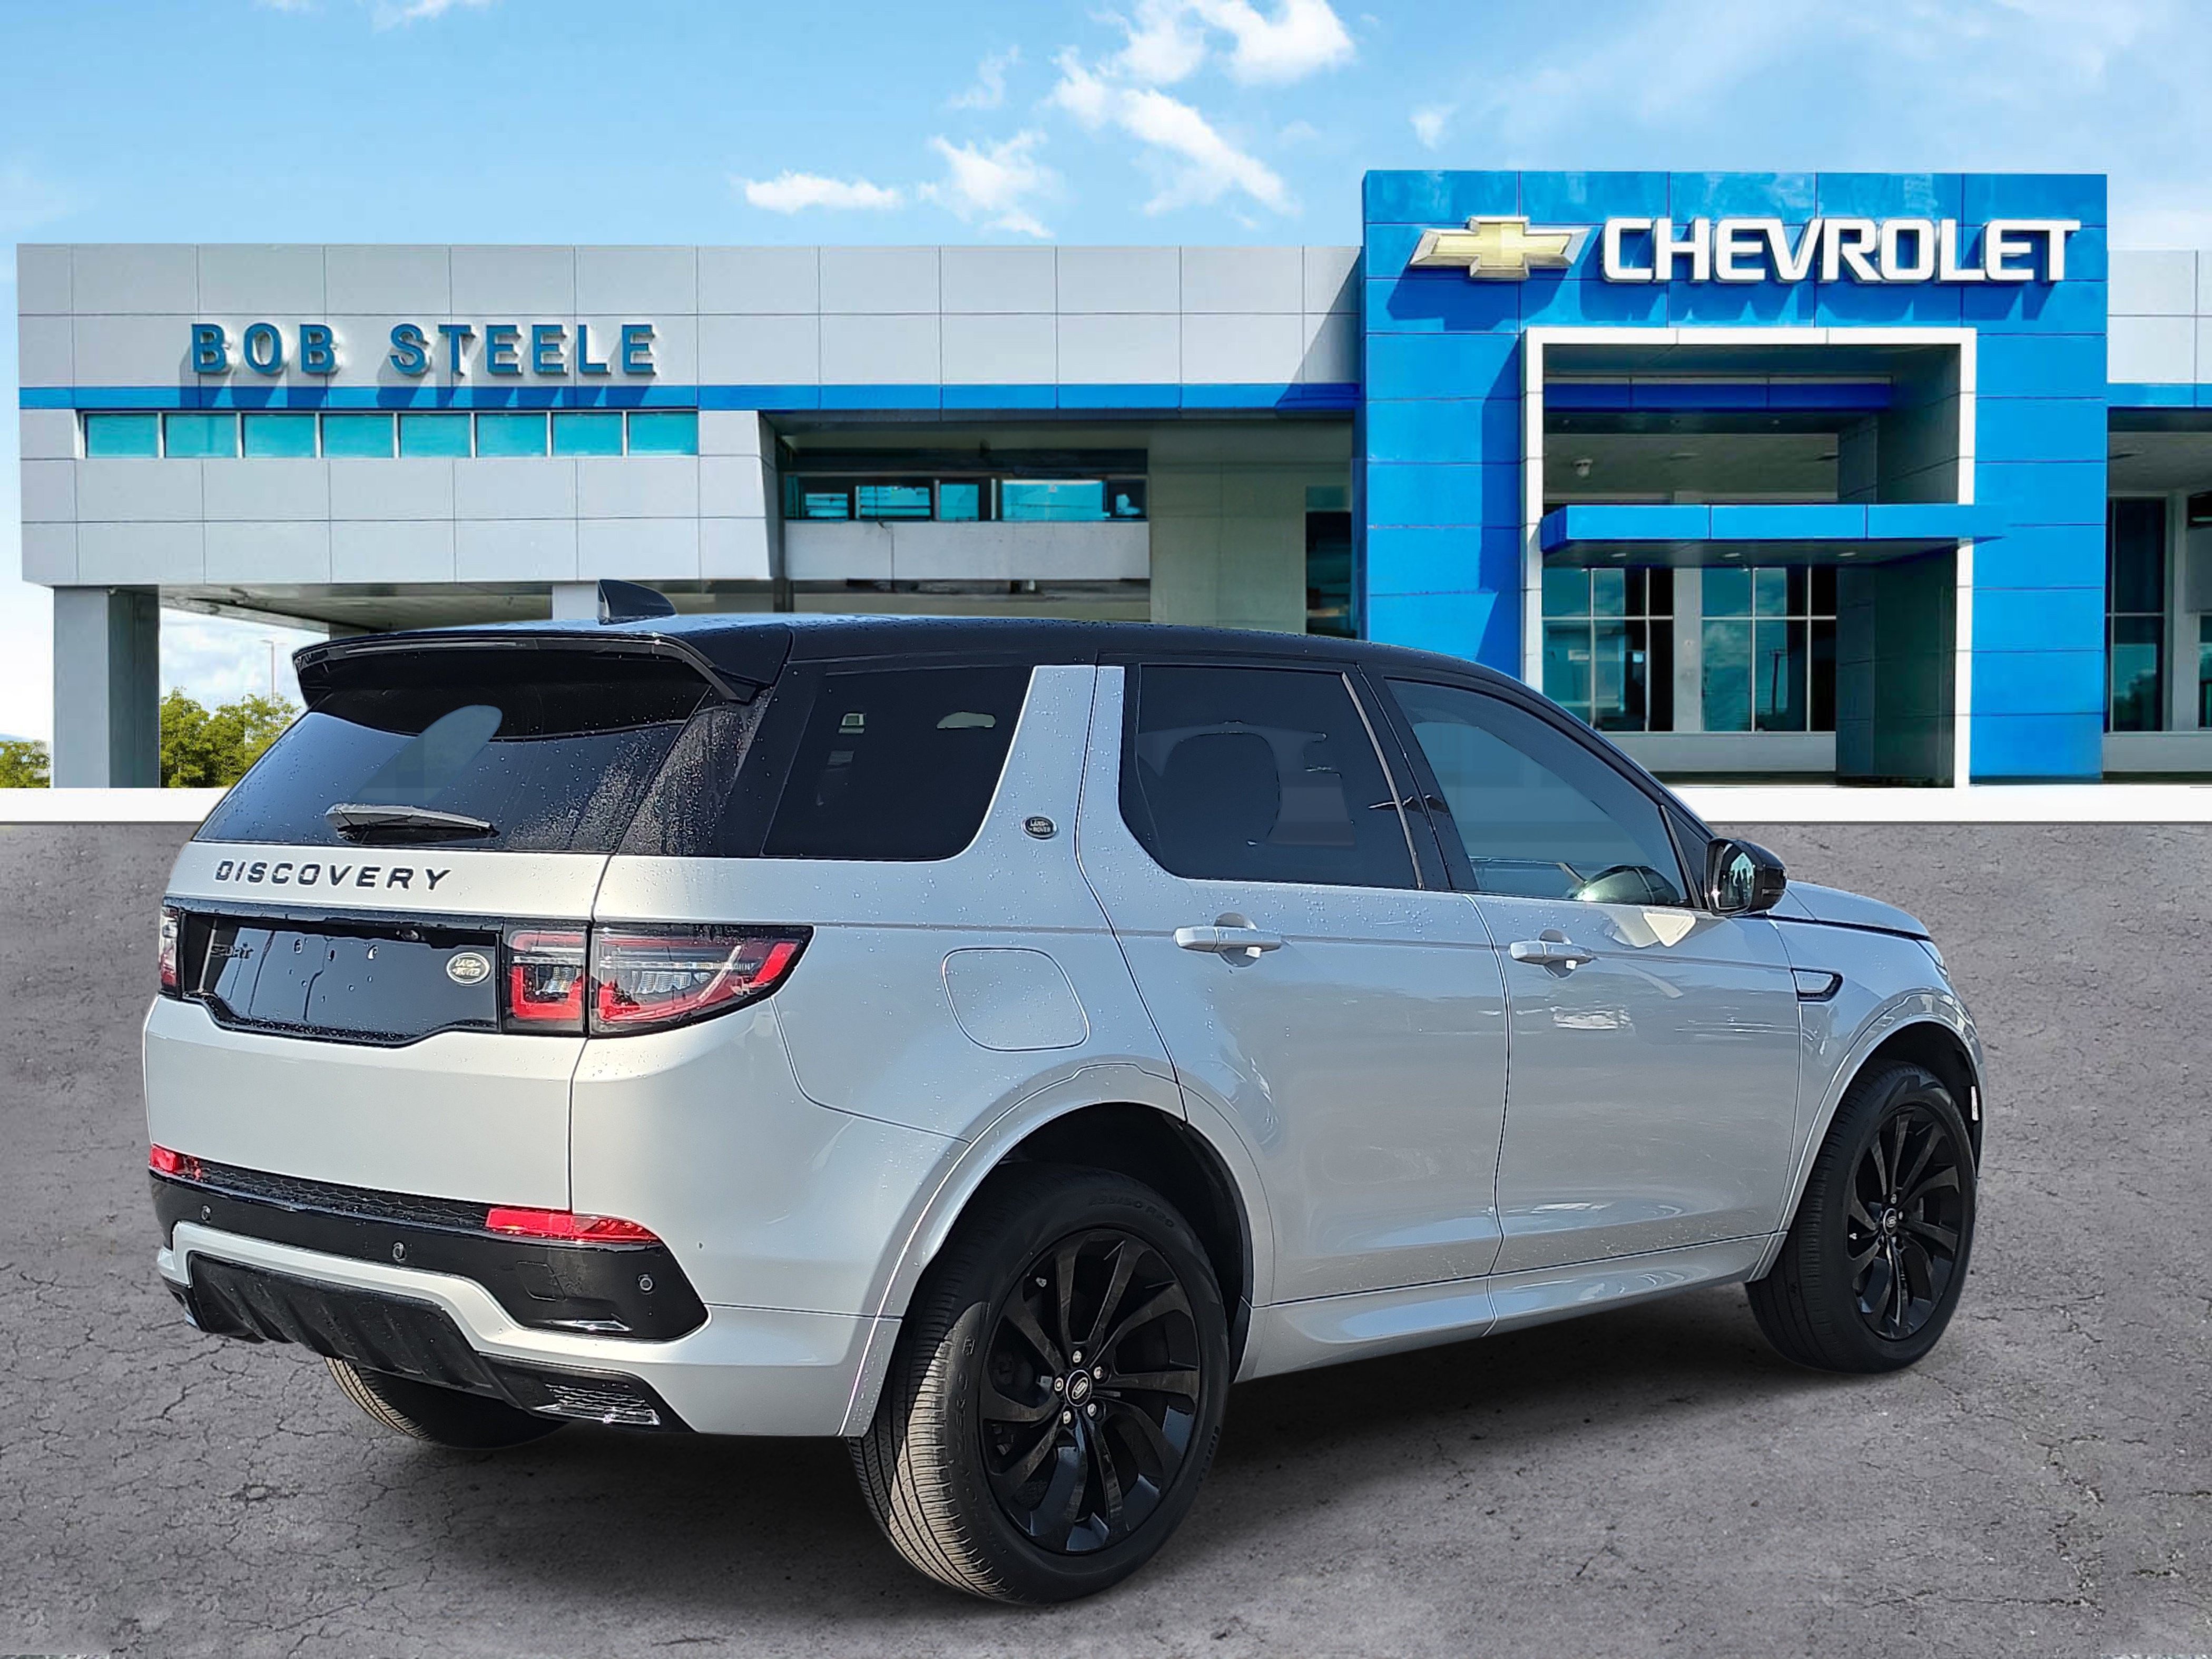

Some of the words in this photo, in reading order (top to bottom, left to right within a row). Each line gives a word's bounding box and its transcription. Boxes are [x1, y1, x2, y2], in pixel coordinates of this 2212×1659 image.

[1602, 217, 2081, 282] CHEVROLET
[191, 323, 339, 375] BOB
[390, 323, 656, 376] STEELE
[214, 860, 451, 891] DISCOVERY
